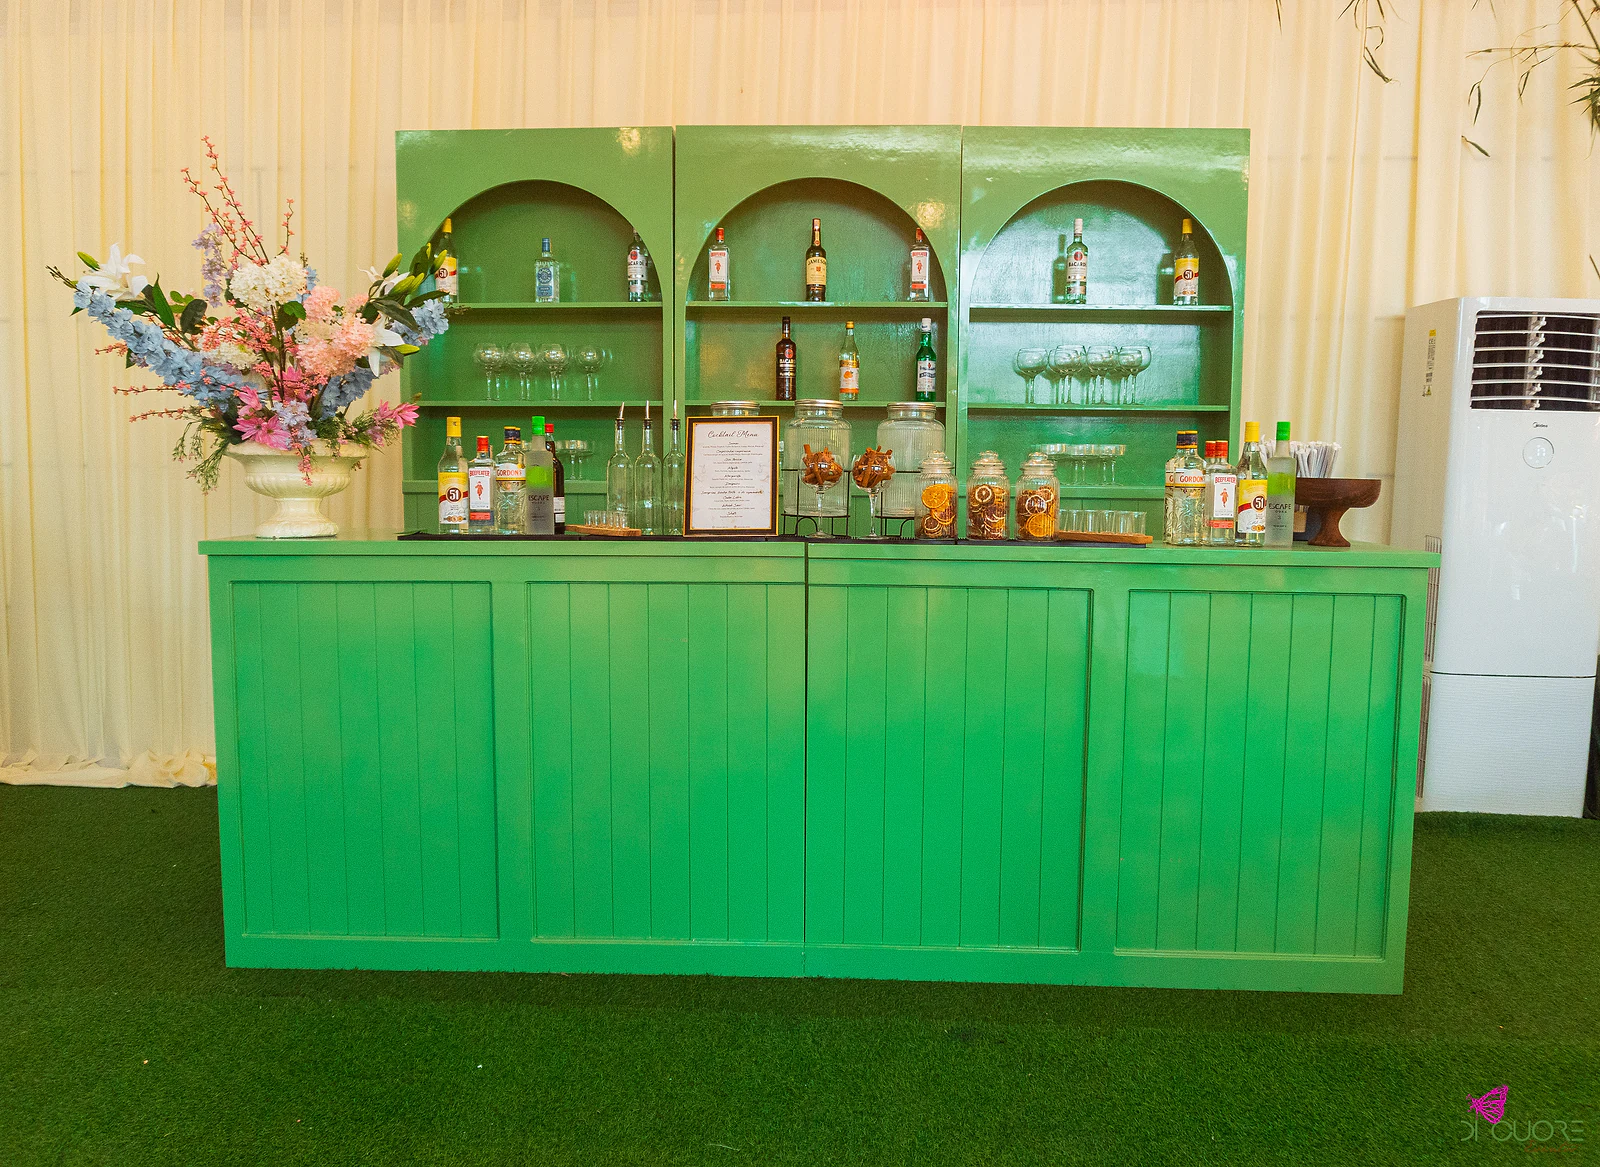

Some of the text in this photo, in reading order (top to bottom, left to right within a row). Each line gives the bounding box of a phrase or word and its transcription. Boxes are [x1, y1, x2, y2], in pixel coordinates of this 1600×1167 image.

[1185, 271, 1193, 279] 51
[449, 489, 459, 500] 51
[1255, 497, 1264, 509] 51
